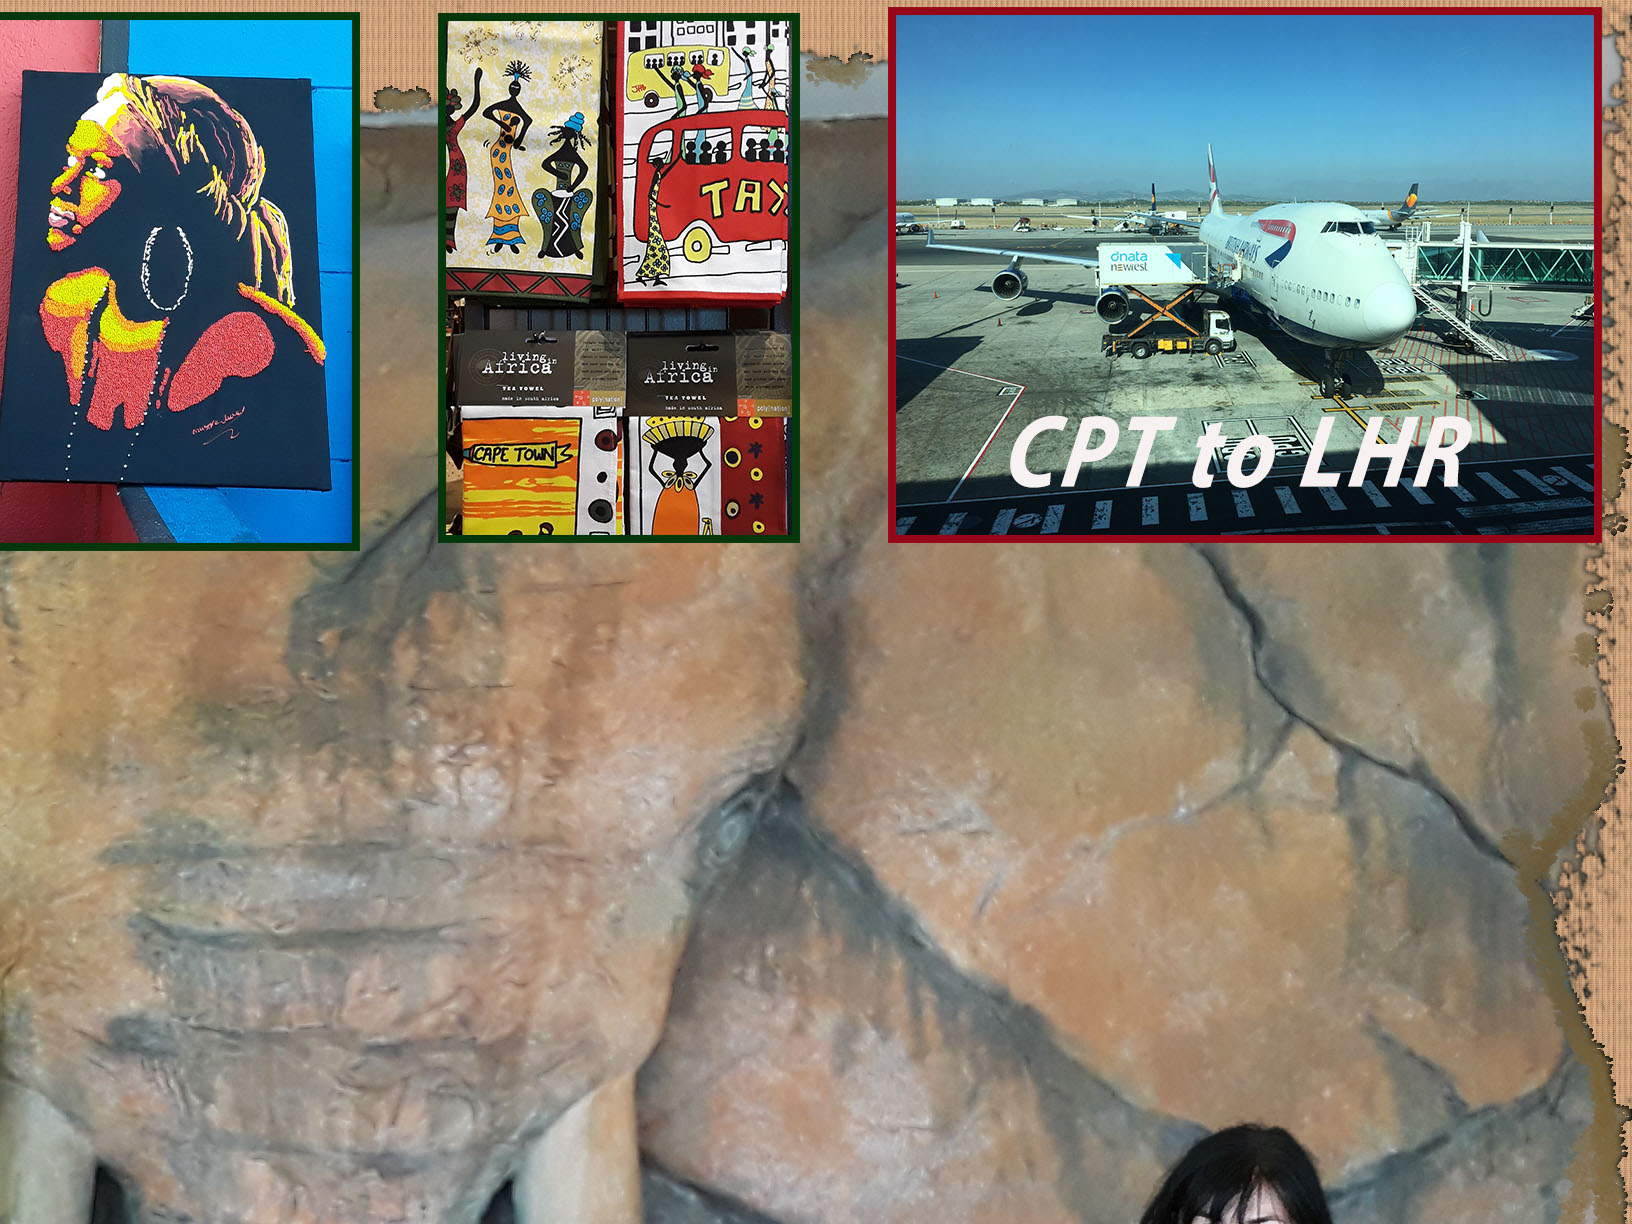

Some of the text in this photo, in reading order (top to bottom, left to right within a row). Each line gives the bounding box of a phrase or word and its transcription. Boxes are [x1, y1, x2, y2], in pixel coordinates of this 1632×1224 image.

[1110, 251, 1148, 262] dnata
[502, 352, 547, 363] living
[481, 360, 553, 374] Africa
[662, 361, 707, 372] living
[644, 369, 714, 384] Africa
[474, 446, 555, 463] CAPE TOWN
